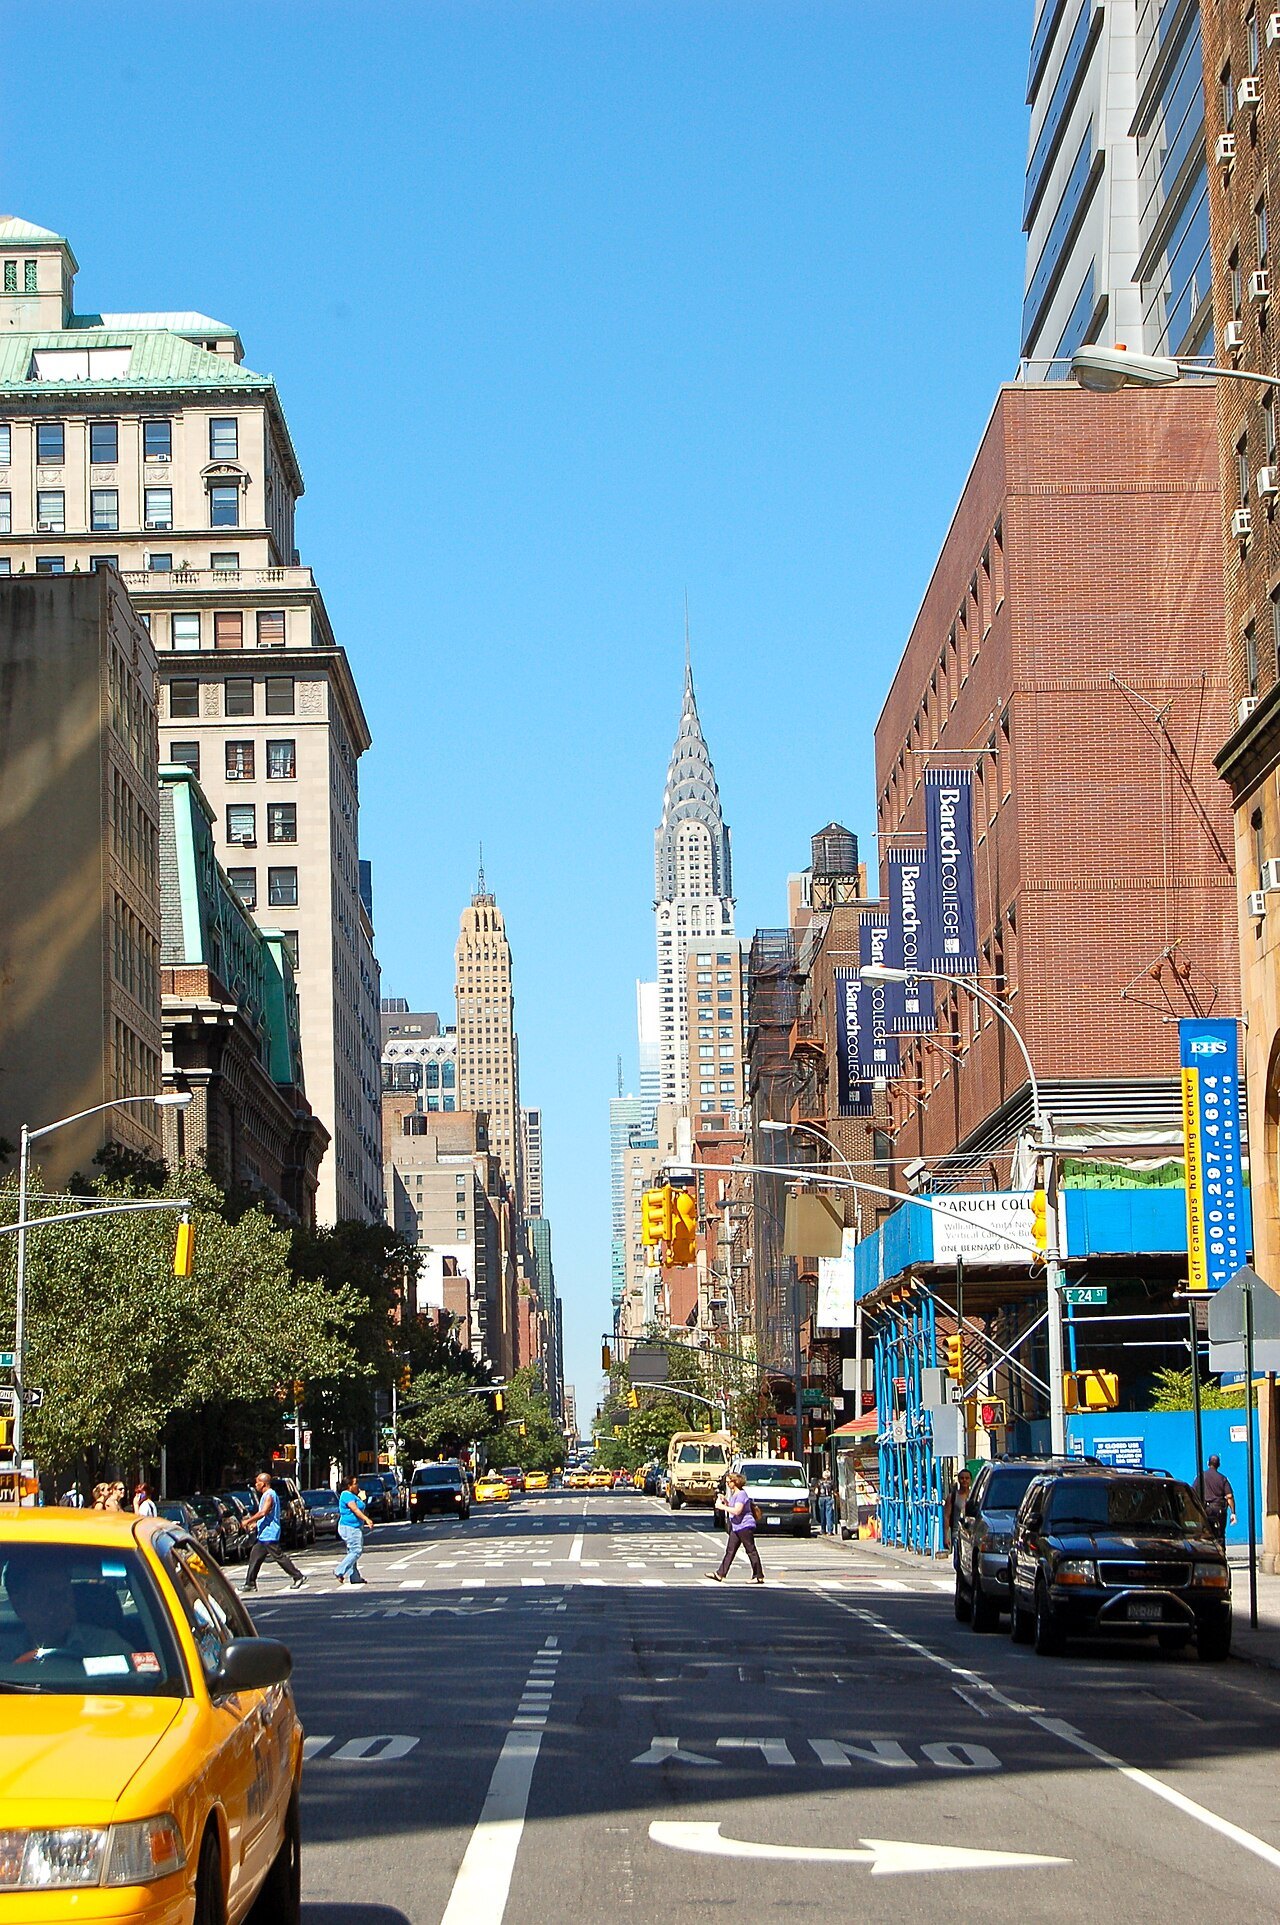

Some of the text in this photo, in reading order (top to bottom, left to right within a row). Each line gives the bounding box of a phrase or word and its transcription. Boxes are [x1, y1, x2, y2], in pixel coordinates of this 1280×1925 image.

[1190, 1041, 1227, 1054] EHS
[1186, 1078, 1201, 1280] off campus housing center
[1204, 1075, 1226, 1281] 1.800.297.4694
[1001, 1199, 1032, 1211] COLL
[960, 1243, 1001, 1252] BERNARD
[1066, 1289, 1103, 1302] E 24 ST
[0, 1488, 16, 1501] UTY
[630, 1735, 1003, 1770] ONLY
